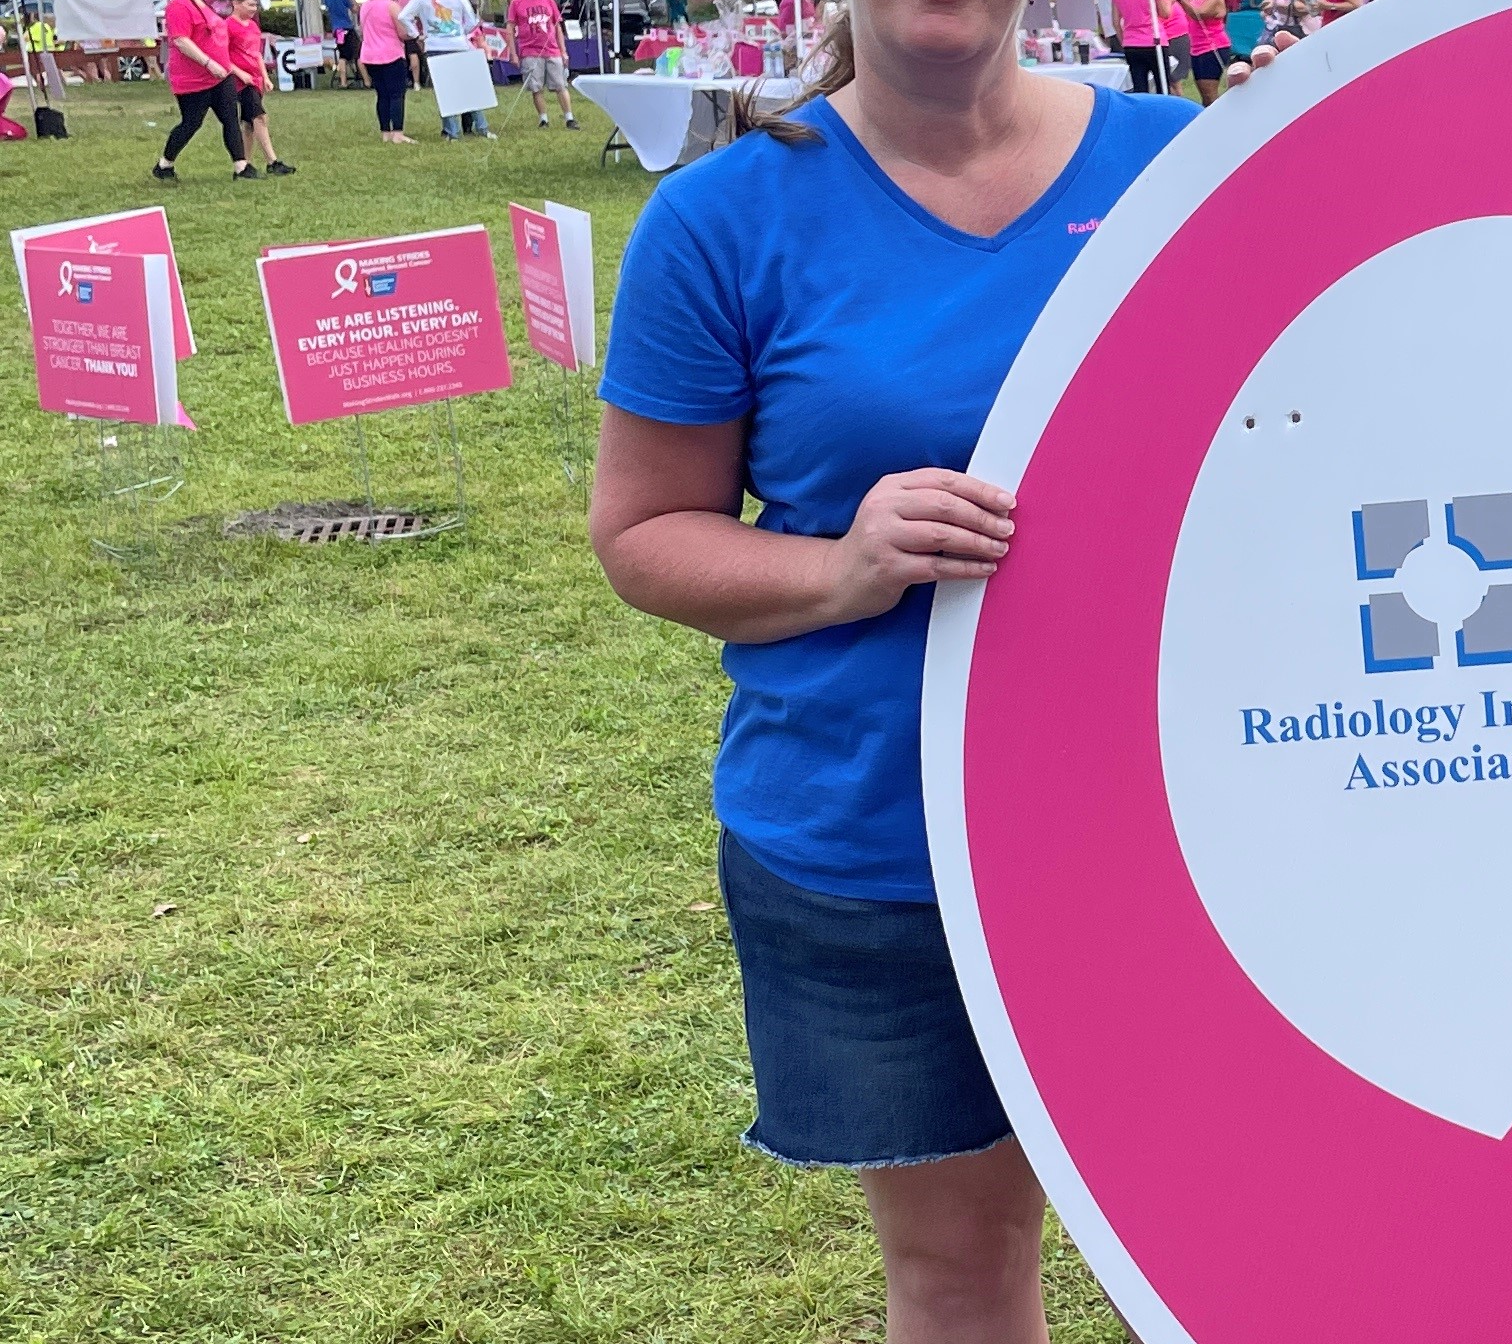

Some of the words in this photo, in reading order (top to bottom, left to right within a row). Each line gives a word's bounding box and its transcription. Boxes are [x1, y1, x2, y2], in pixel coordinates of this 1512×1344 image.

[298, 334, 346, 352] EVERY
[350, 326, 399, 343] HOUR.
[402, 317, 449, 335] EVERY
[451, 310, 483, 326] DAY.
[316, 318, 341, 332] WE
[343, 312, 374, 329] ARE
[376, 298, 460, 323] LISTENING.
[42, 336, 84, 354] STRONGER
[85, 340, 109, 357] THAN
[109, 343, 141, 360] BREAST
[306, 345, 365, 366] BECAUSE
[367, 337, 424, 356] HEALING
[425, 326, 480, 347] DOESN'T
[328, 362, 359, 379] JUST
[362, 353, 415, 372] HAPPEN
[417, 344, 466, 364] DURING
[84, 357, 115, 375] THANK
[115, 362, 138, 378] YOU!
[342, 371, 406, 391] BUSINESS
[408, 361, 456, 380] HOURS.
[1239, 699, 1466, 746] Radiology
